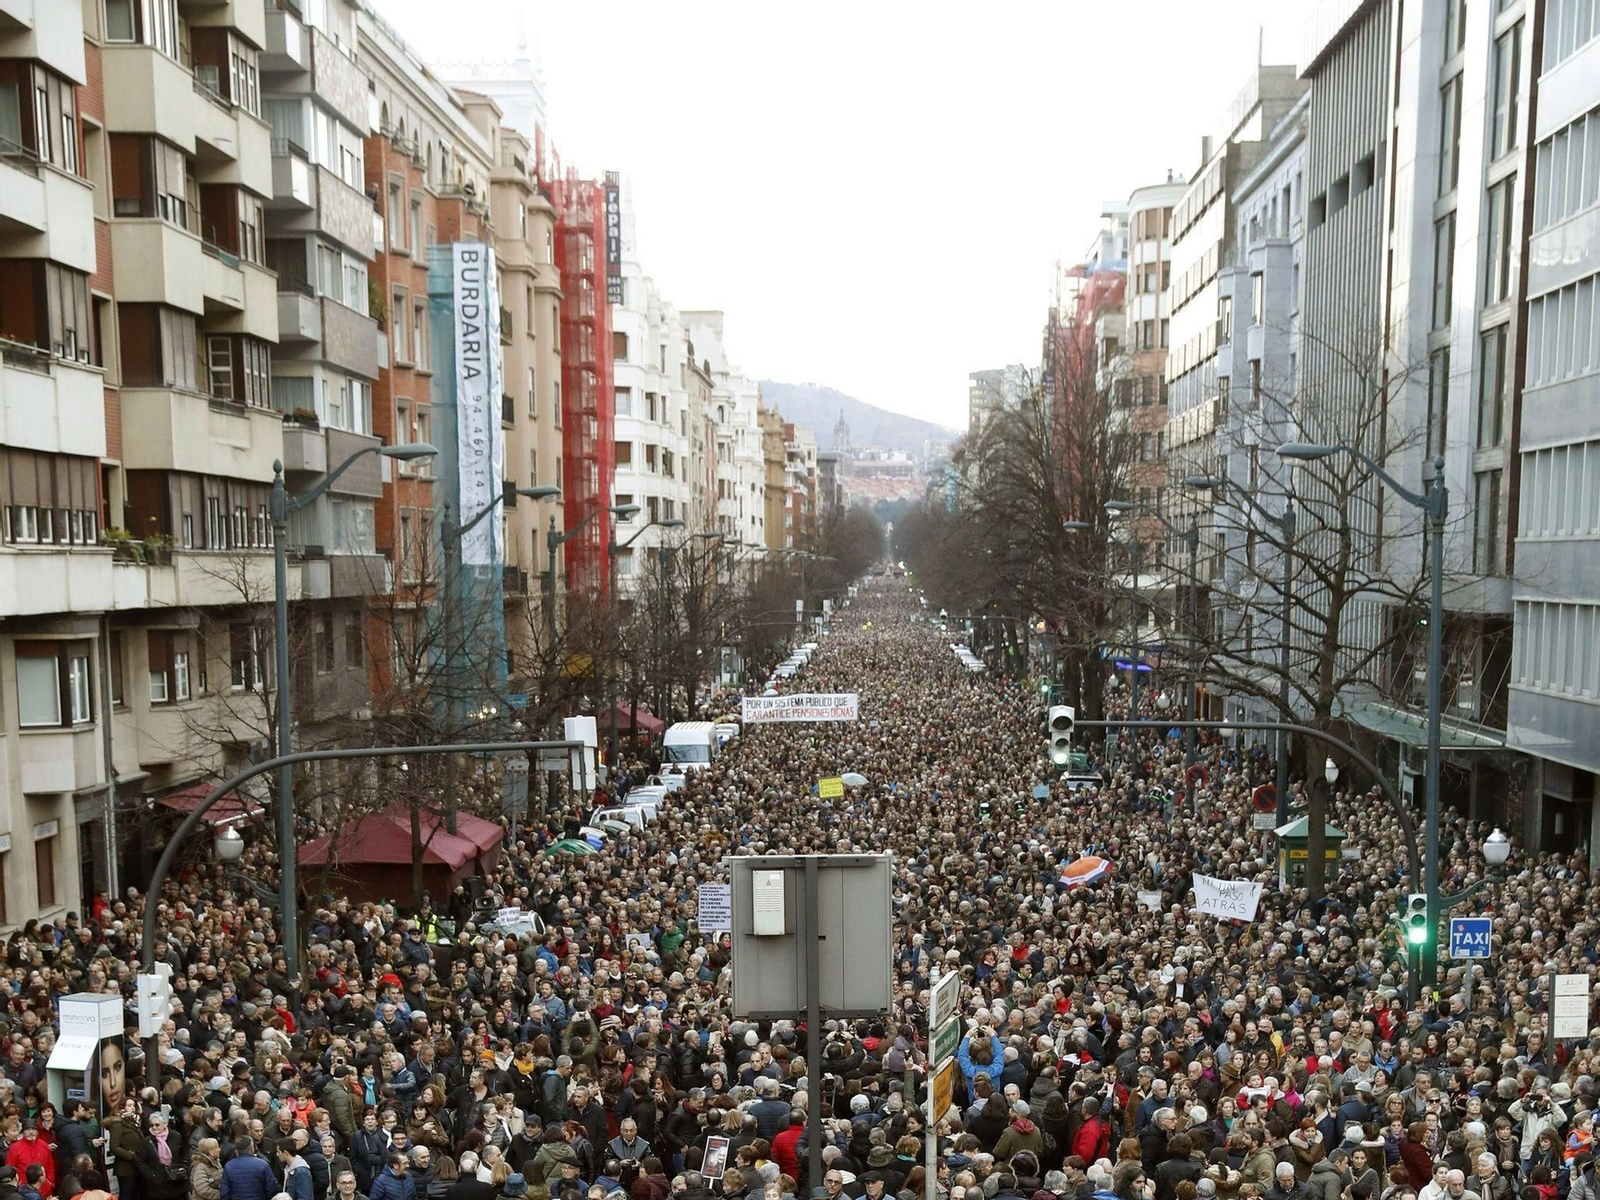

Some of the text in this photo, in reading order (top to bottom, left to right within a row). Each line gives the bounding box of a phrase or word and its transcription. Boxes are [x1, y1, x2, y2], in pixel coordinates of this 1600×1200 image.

[608, 192, 619, 262] repair
[461, 251, 481, 380] BURDARIA
[746, 699, 760, 709] POR
[763, 699, 773, 709] UN
[774, 697, 804, 708] SISTEMA
[834, 697, 848, 707] QUE
[746, 707, 854, 720] GARANTICE PENSIONES DIGNAS
[1219, 890, 1244, 901] PASO
[1453, 932, 1489, 945] TAXI
[62, 1014, 96, 1023] minerva
